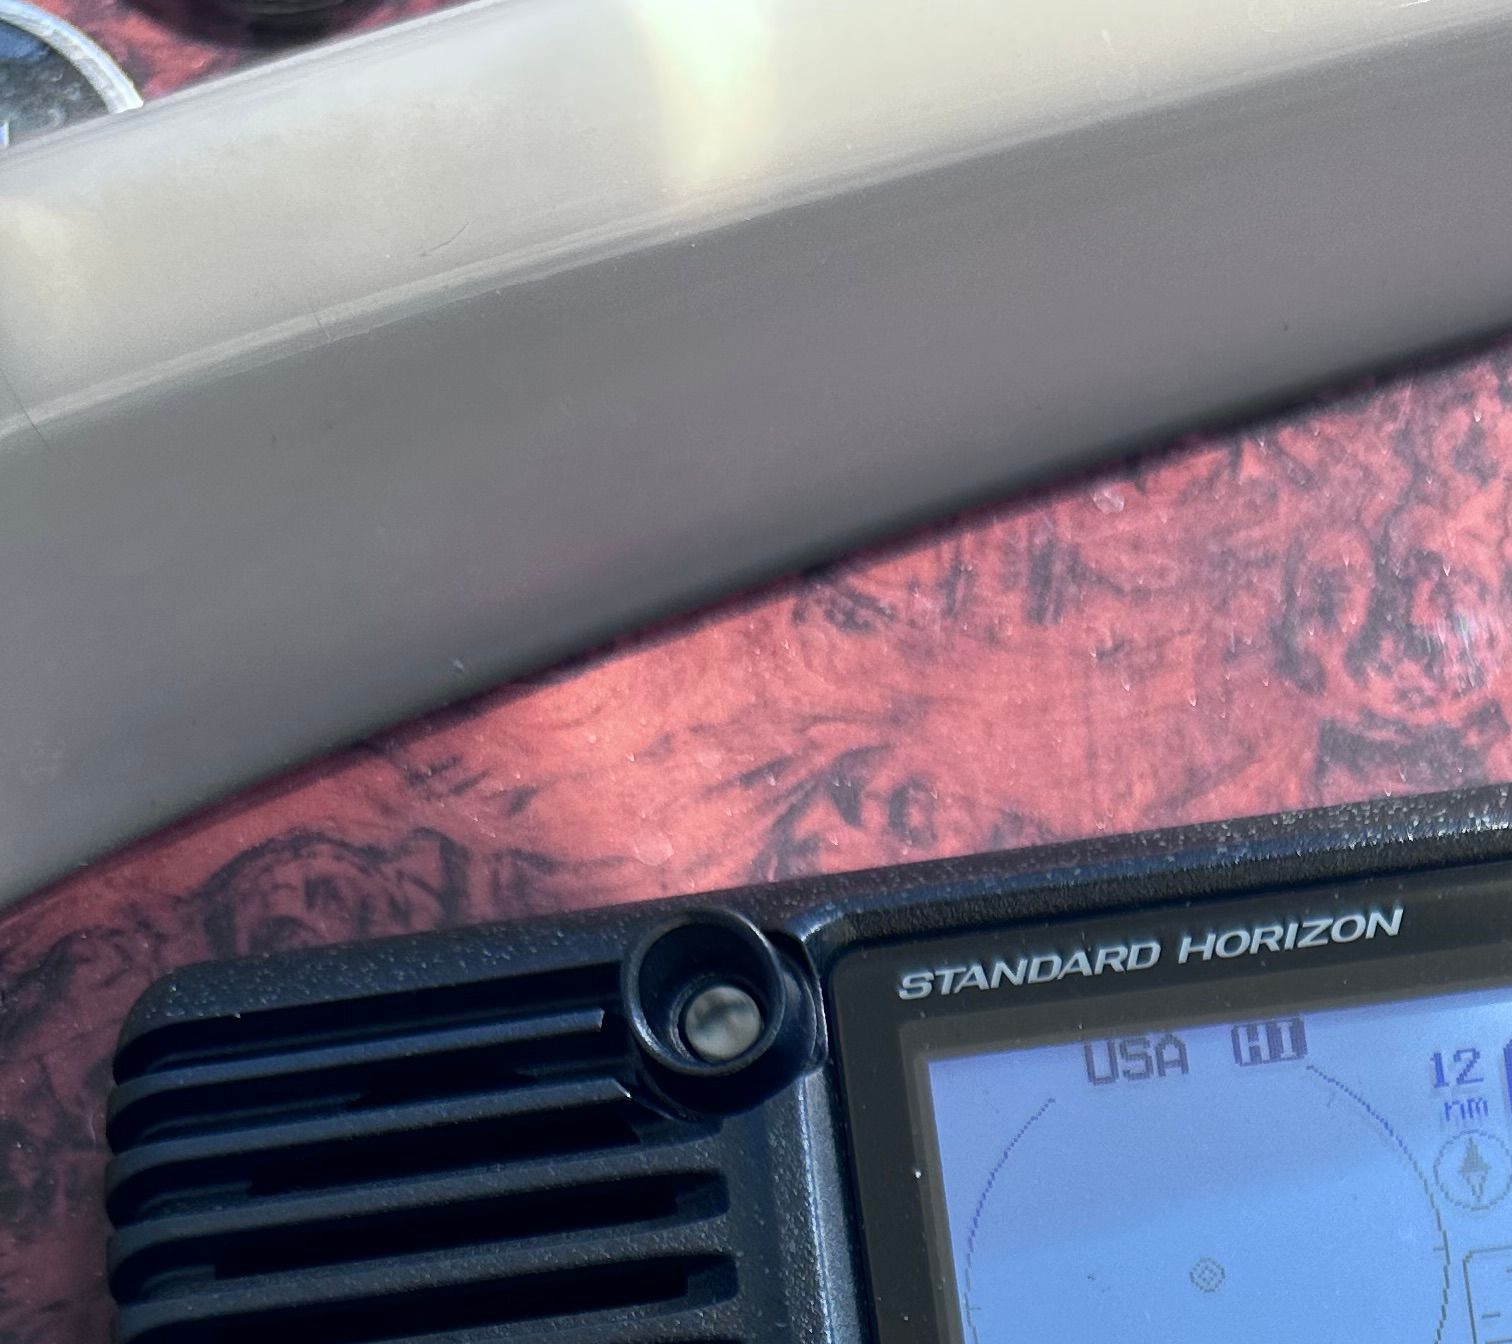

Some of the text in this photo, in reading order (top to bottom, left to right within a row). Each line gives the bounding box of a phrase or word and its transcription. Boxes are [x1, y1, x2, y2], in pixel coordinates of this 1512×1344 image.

[899, 908, 1404, 1000] STANDARD HORIZON
[1082, 1021, 1298, 1086] USA HI
[1430, 1047, 1484, 1088] 12
[1443, 1096, 1489, 1122] nm
